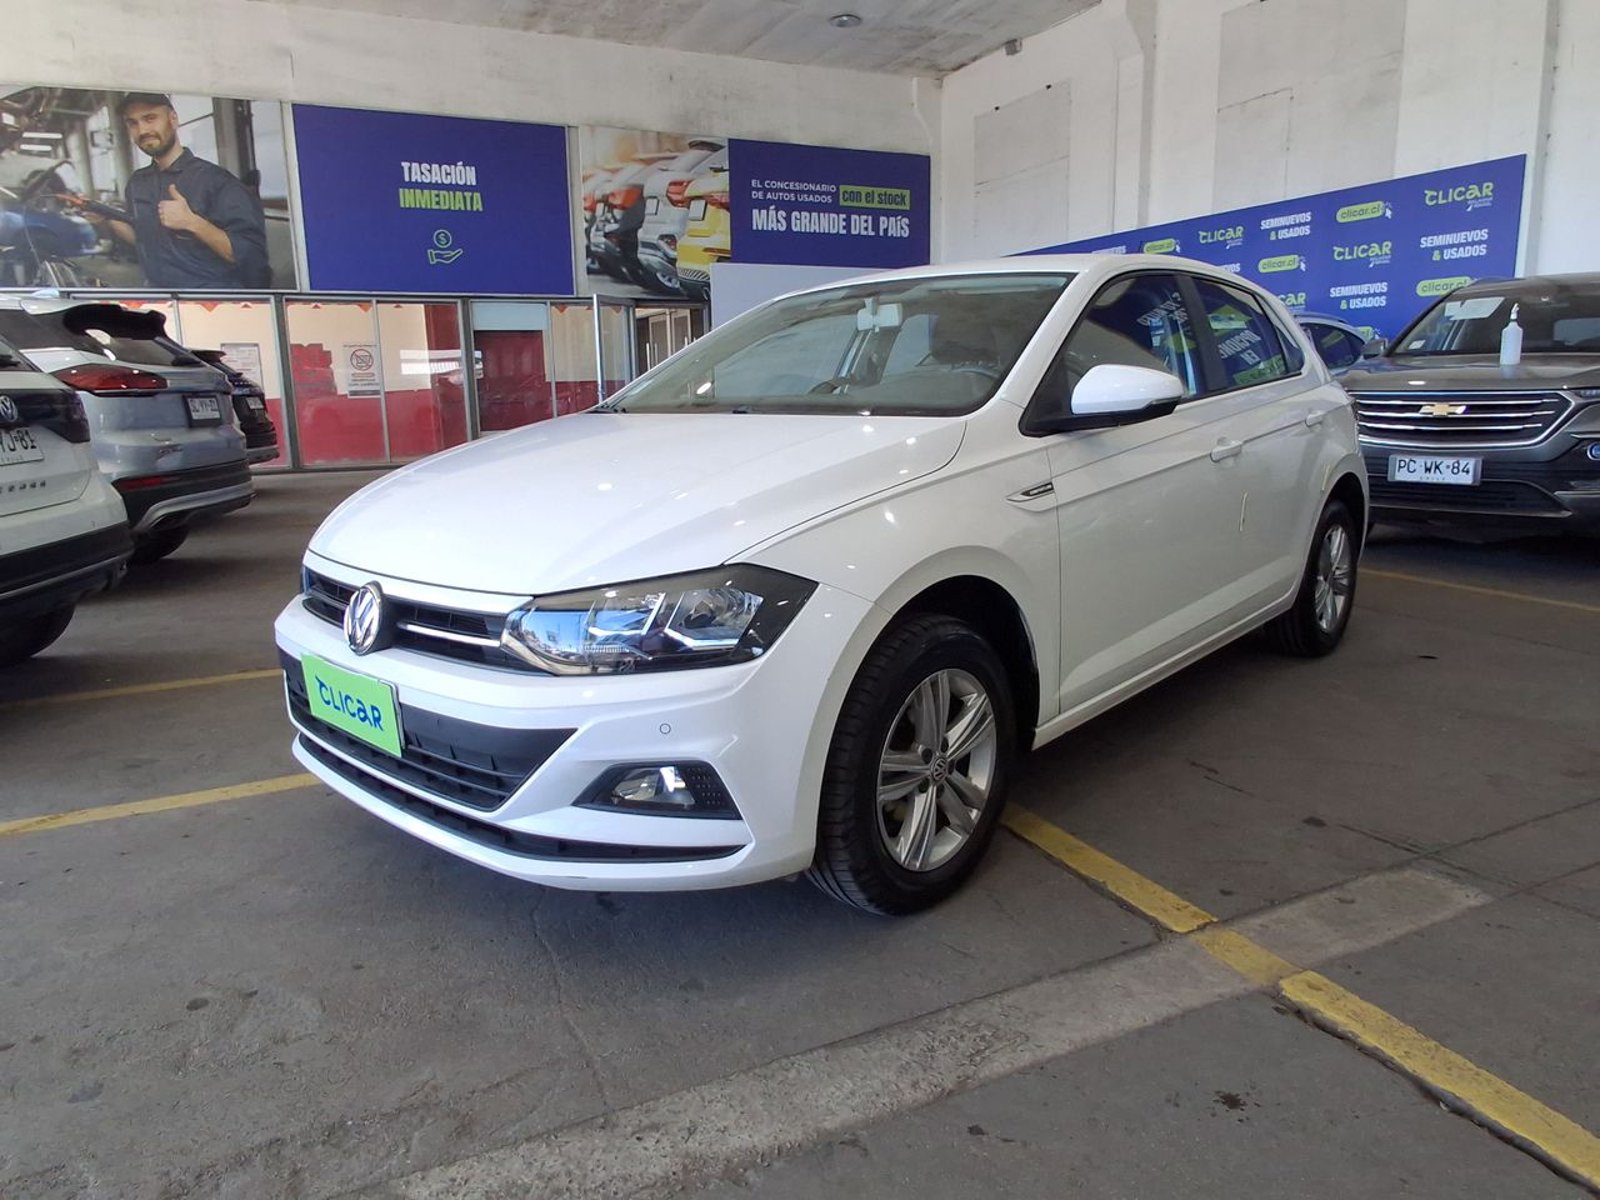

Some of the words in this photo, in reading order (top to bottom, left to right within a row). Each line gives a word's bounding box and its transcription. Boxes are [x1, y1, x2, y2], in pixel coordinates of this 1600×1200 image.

[401, 161, 477, 186] TASACIÓN
[751, 179, 763, 189] EL
[764, 180, 837, 193] CONCESIONARIO
[399, 188, 484, 212] INMEDIATA
[751, 191, 765, 201] DE
[766, 191, 796, 202] AUTOS
[797, 193, 833, 204] USADOS
[842, 189, 862, 203] con
[865, 189, 875, 202] el
[877, 192, 907, 207] stock
[752, 205, 787, 232] MÁS
[791, 211, 847, 235] GRANDE
[850, 214, 876, 237] DEL
[879, 216, 910, 238] PAÍS
[1260, 211, 1312, 230] SEMINUEVOS
[1277, 225, 1311, 240] USADOS
[1420, 228, 1489, 249] SEMINUEVOS
[1443, 244, 1487, 260] USADOS
[1329, 282, 1388, 298] SEMINUEVOS
[1349, 296, 1387, 309] USADOS
